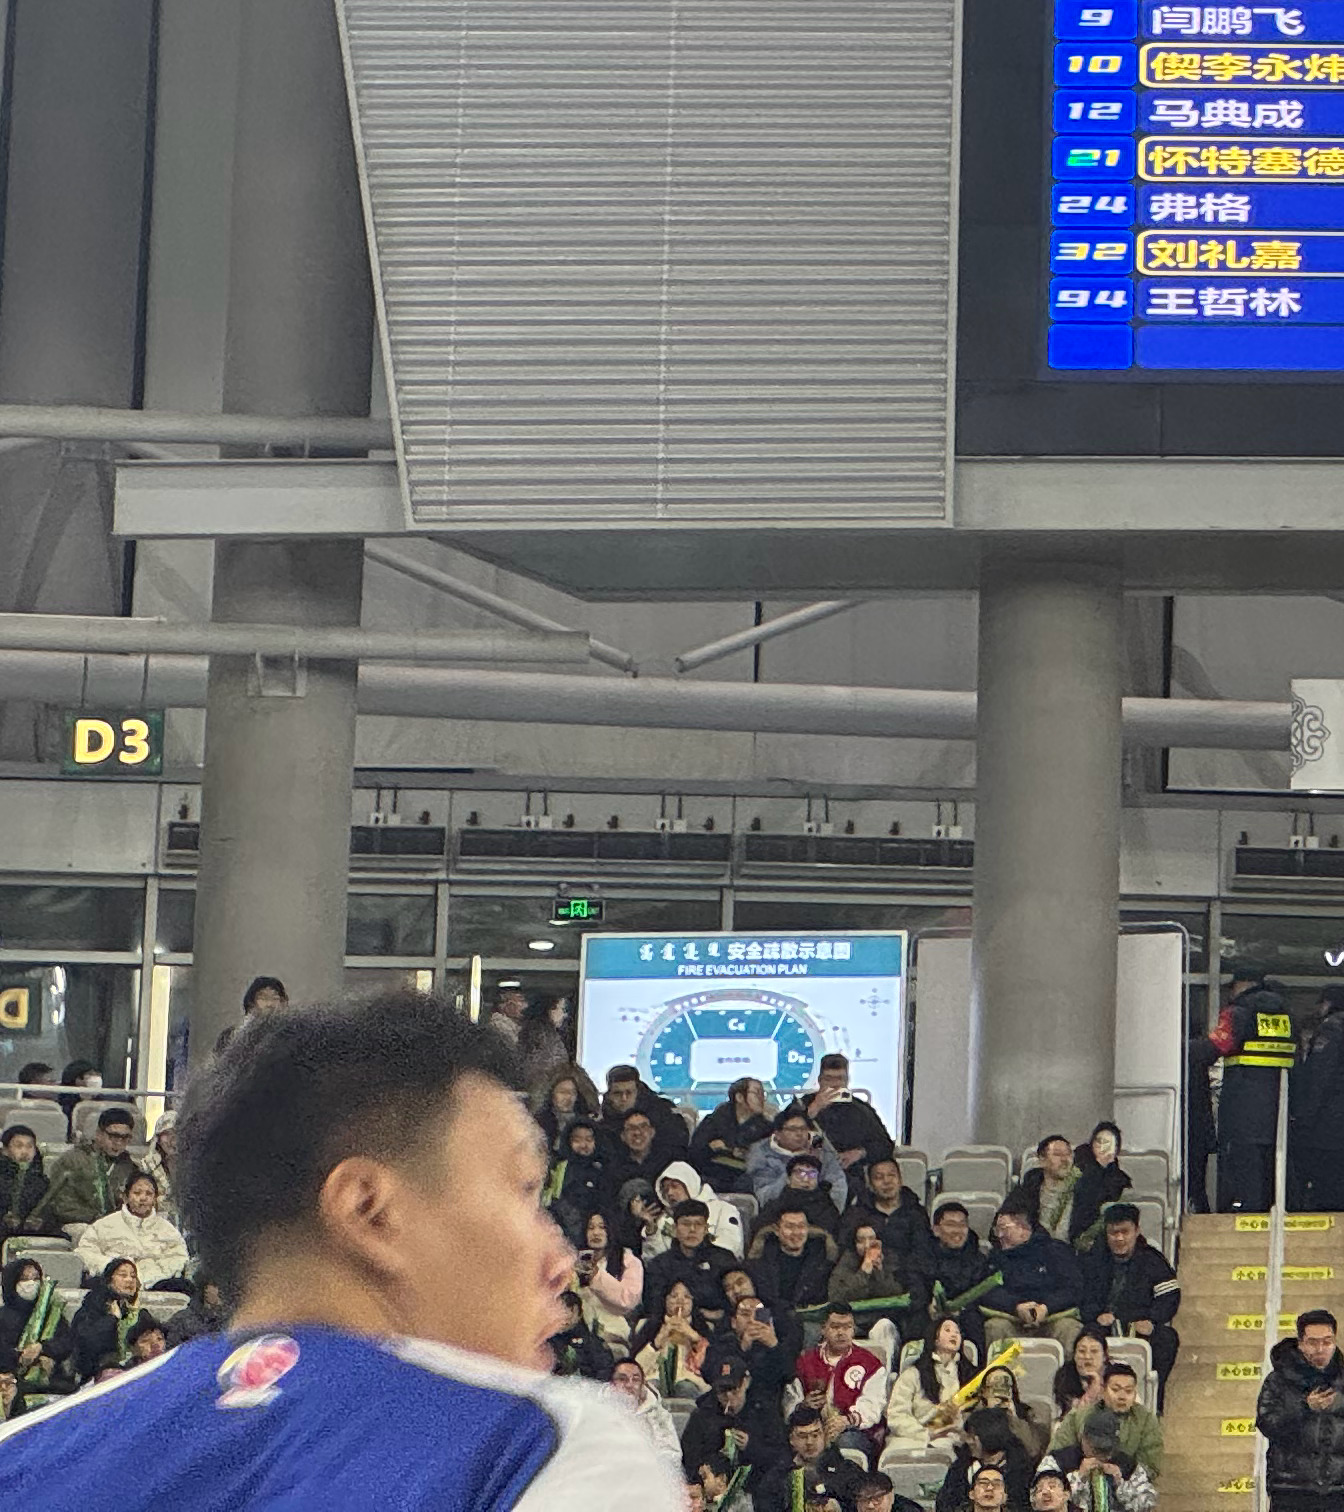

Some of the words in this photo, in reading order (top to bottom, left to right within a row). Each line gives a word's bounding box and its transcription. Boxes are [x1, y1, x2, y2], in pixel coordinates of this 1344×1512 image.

[1079, 9, 1113, 27] 9
[1151, 5, 1306, 36] 闫鹏飞
[1068, 55, 1123, 73] 10
[1069, 102, 1123, 120] 12
[1148, 98, 1305, 129] 马典成
[1065, 148, 1122, 169] 21
[1058, 195, 1128, 214] 24
[1149, 192, 1252, 223] 弗格
[1055, 242, 1128, 261] 32
[1144, 239, 1303, 272] 刘礼嘉
[1056, 290, 1127, 308] 94
[1145, 286, 1302, 317] 王哲林
[73, 718, 150, 765] D3
[677, 964, 705, 976] FIRE
[705, 964, 776, 977] EVACUATION
[777, 963, 809, 976] PLAN
